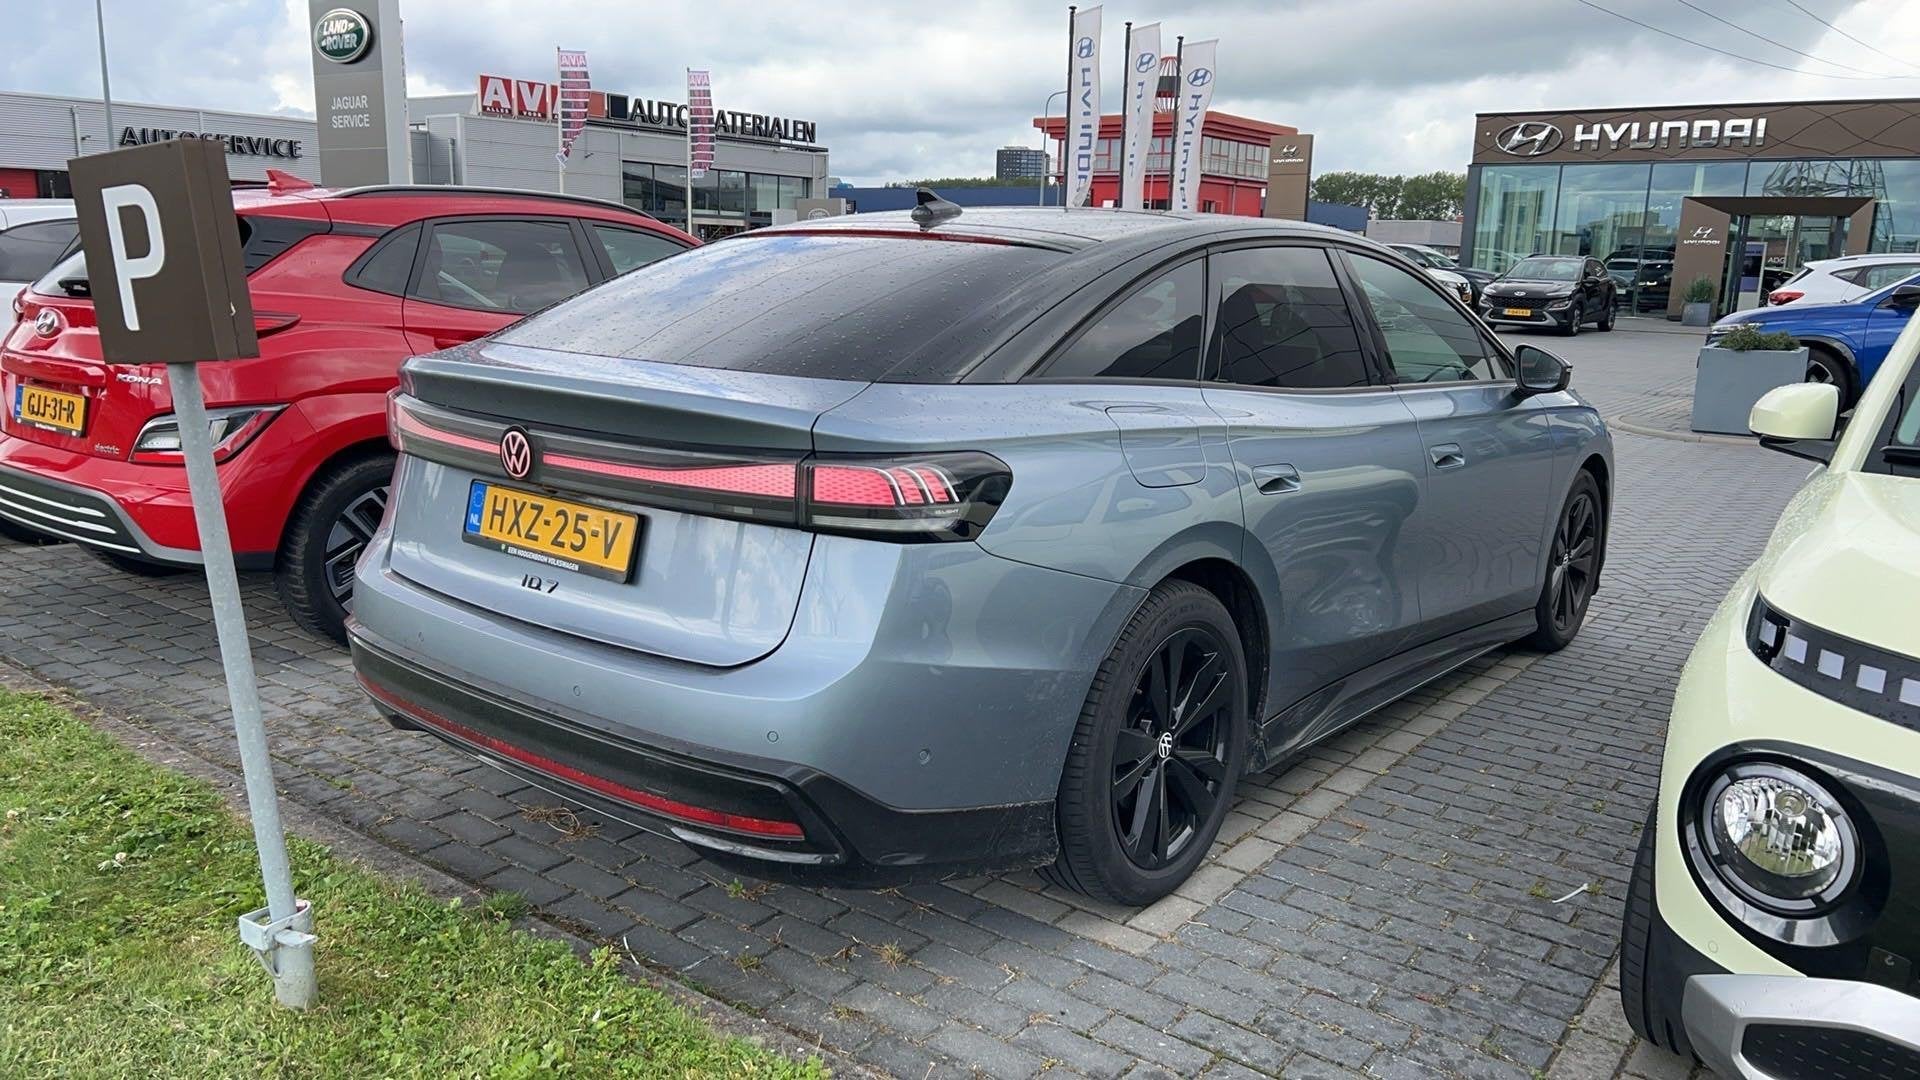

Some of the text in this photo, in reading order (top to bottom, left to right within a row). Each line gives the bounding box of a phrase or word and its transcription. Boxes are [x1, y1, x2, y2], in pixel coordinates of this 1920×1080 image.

[323, 19, 348, 34] LAND
[326, 33, 357, 51] ROVER
[331, 95, 368, 110] JAGUAR
[486, 106, 542, 118] ALLES VOOR
[630, 97, 816, 143] AUTOATERIALEN
[331, 114, 370, 128] SERVICE
[1573, 117, 1768, 151] HYUNDAI
[101, 183, 165, 332] P
[116, 373, 163, 386] KONA
[27, 392, 75, 425] GJJ-31-R
[469, 513, 481, 527] NL
[489, 494, 622, 559] HXZ-25-V
